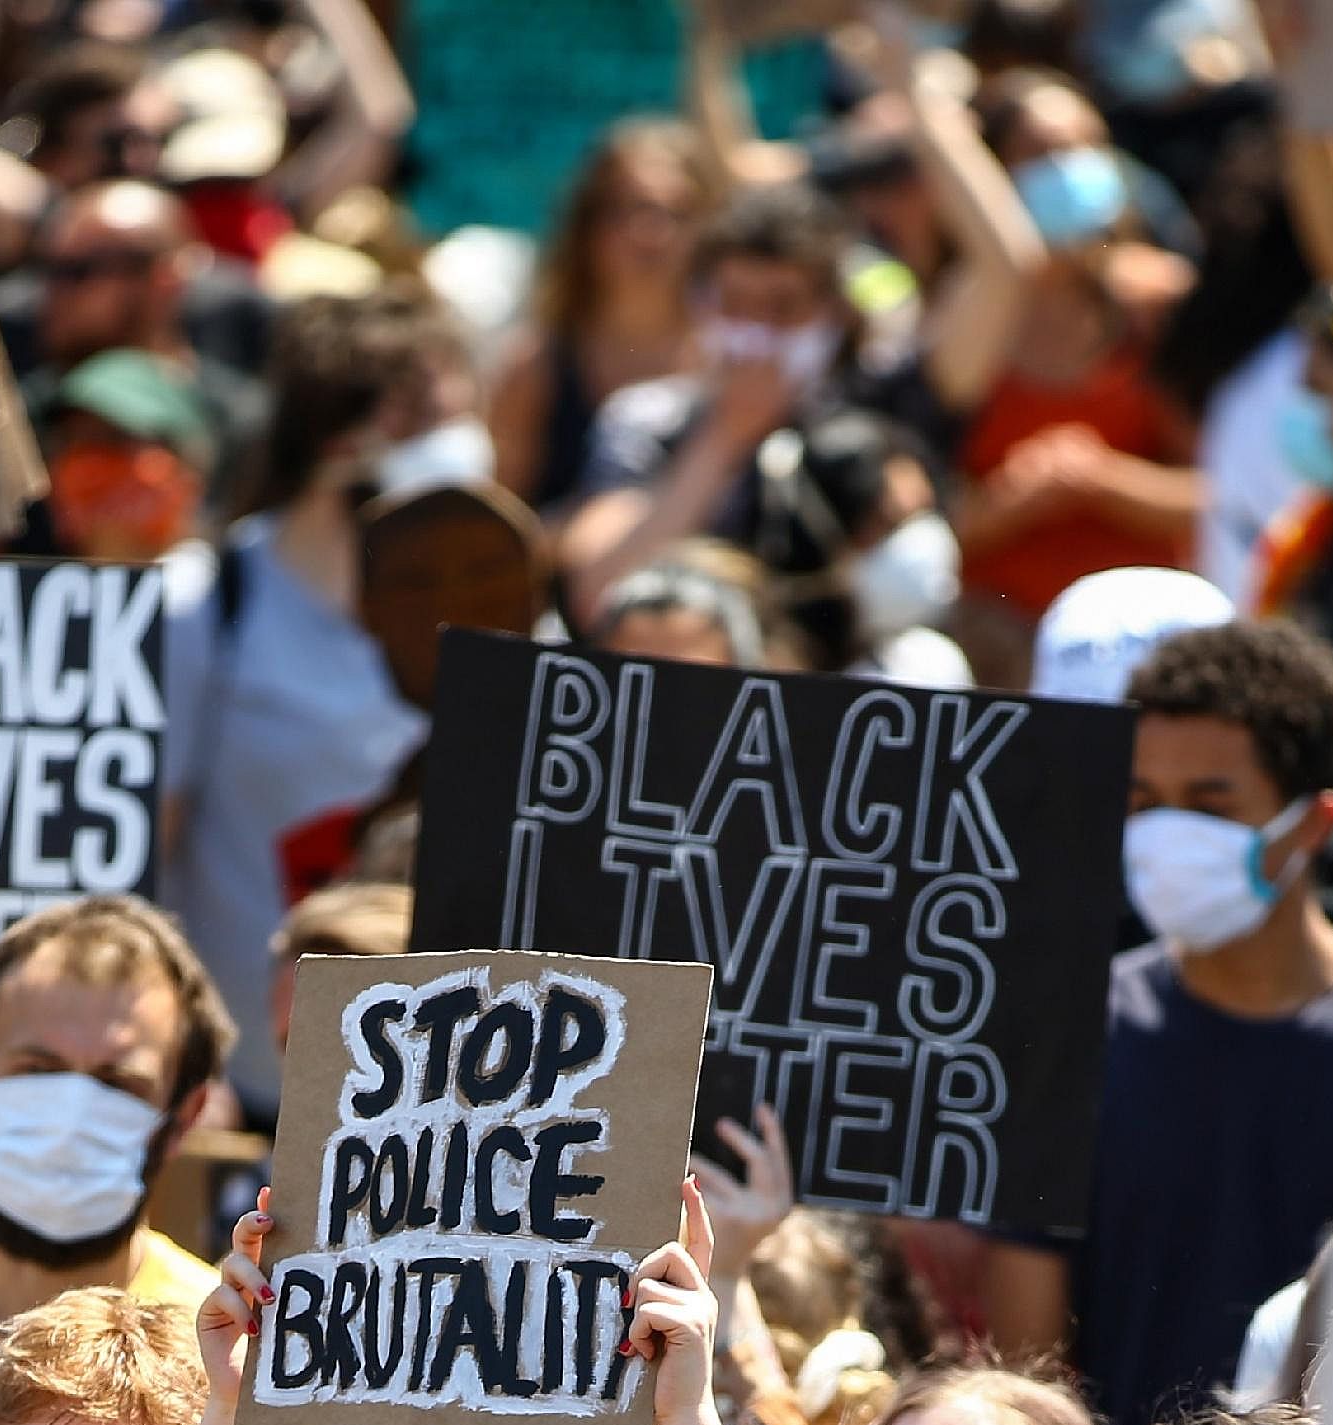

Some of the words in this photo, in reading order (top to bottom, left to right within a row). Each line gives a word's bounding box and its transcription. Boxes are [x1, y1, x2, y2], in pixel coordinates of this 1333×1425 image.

[518, 652, 1029, 880] BLACK
[350, 984, 606, 1118] STOP
[329, 1121, 605, 1245] POLICE
